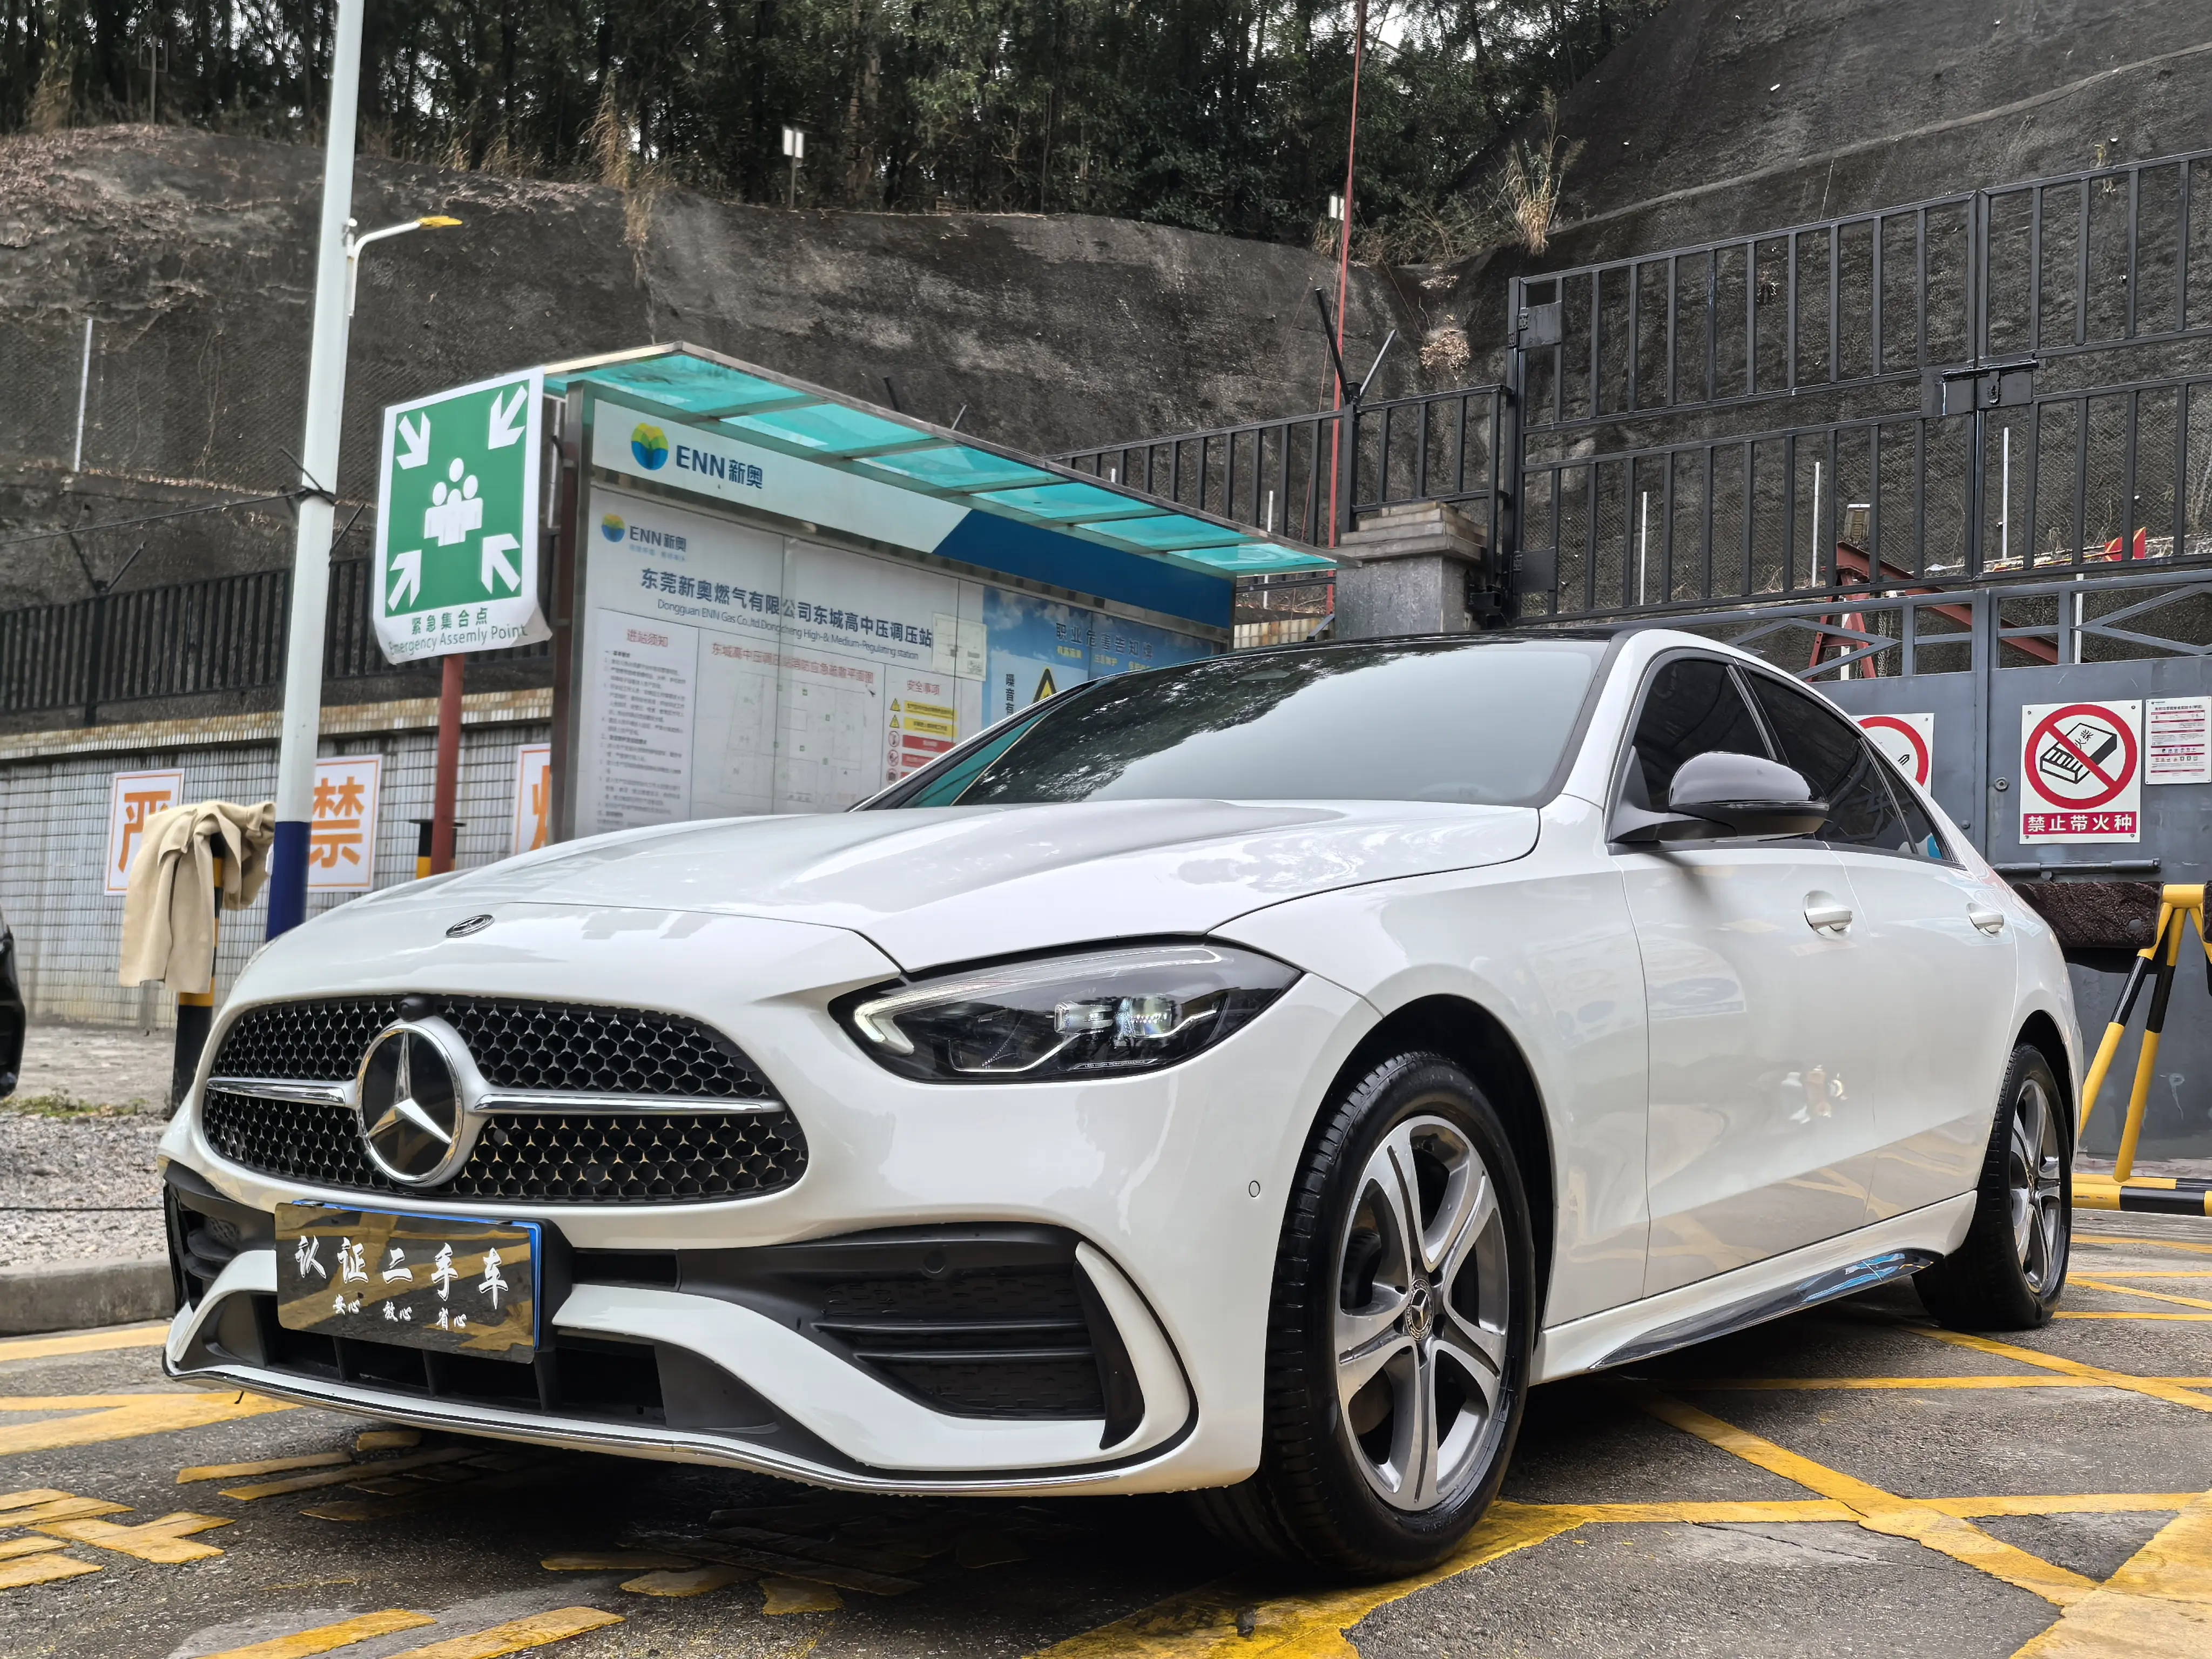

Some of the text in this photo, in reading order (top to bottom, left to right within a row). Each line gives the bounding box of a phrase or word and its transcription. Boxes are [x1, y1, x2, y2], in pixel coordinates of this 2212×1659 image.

[412, 607, 488, 635] 紧急集合点
[641, 568, 933, 648] 东莞新奥燃气有限公司东城高中压调压站
[658, 599, 700, 616] Dongguan
[702, 608, 720, 621] ENN
[721, 612, 735, 623] Gas
[439, 628, 488, 646] Assemly
[491, 624, 528, 640] Point
[2027, 814, 2132, 832] 禁止带火种
[295, 1235, 509, 1310] 认证二手车
[382, 1300, 413, 1322] 放心
[436, 1307, 467, 1331] 省心
